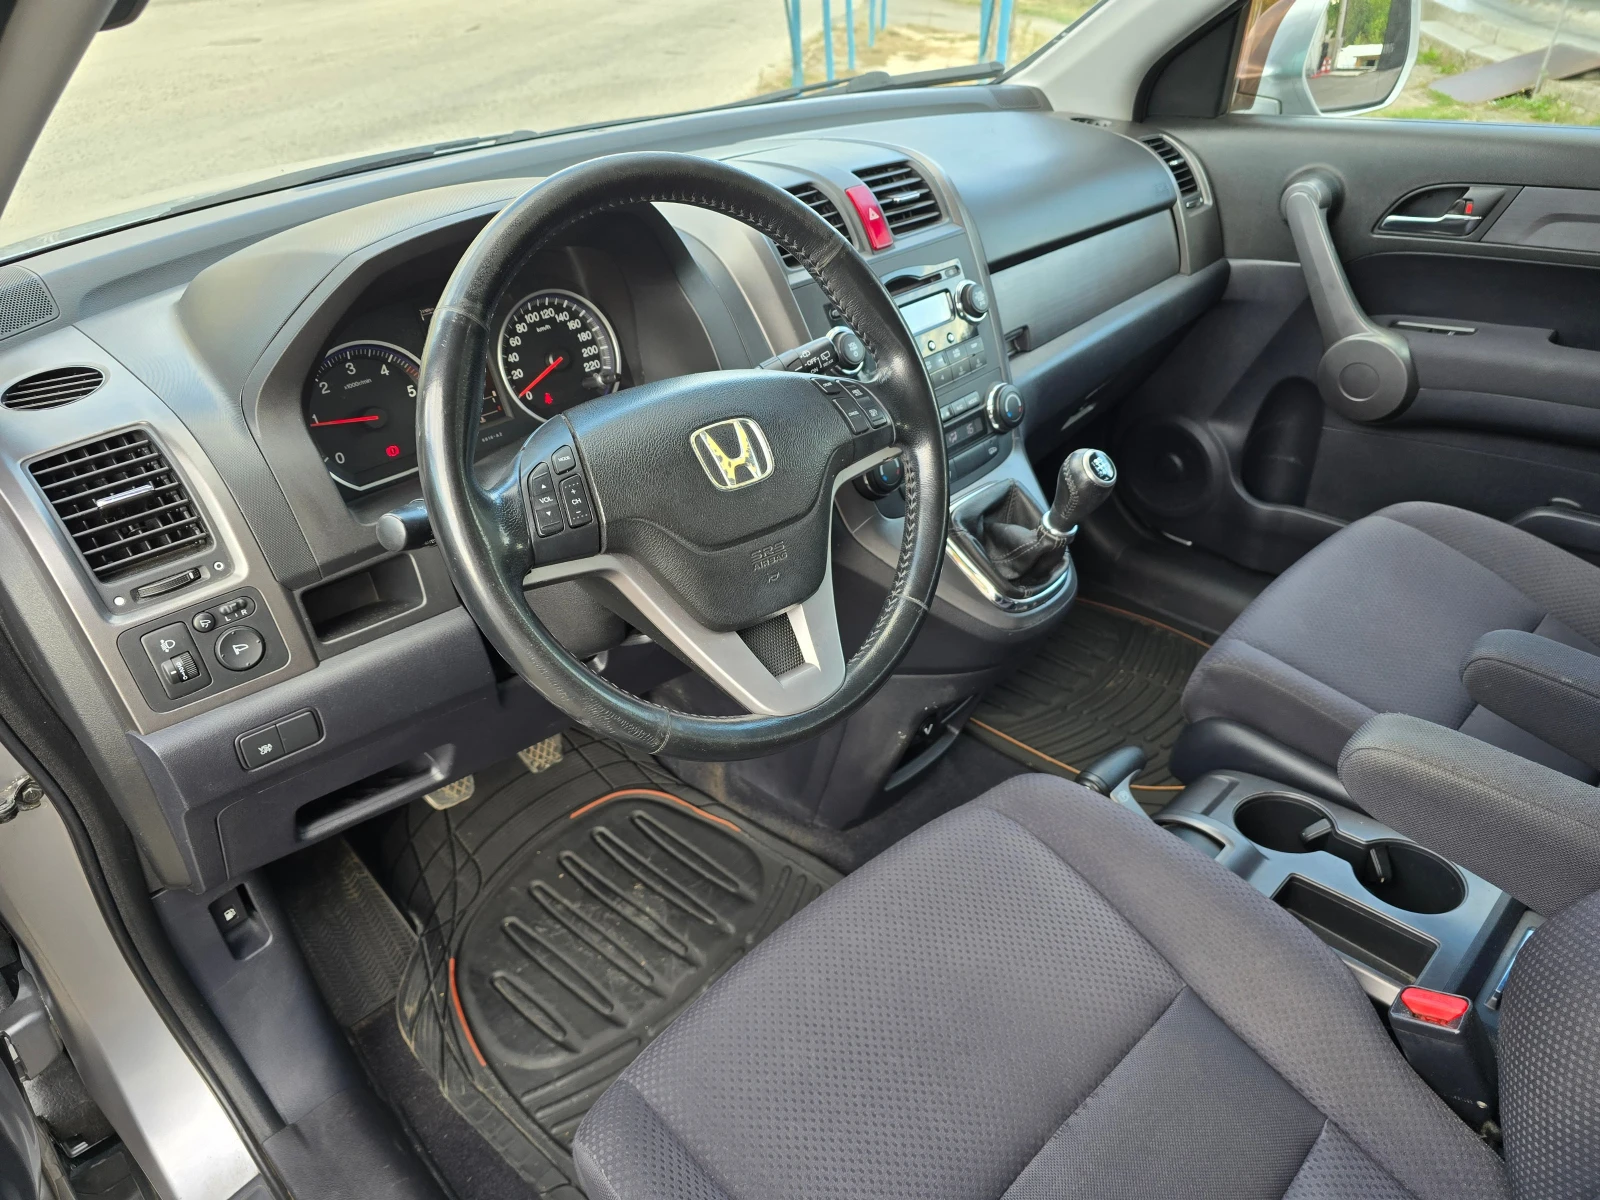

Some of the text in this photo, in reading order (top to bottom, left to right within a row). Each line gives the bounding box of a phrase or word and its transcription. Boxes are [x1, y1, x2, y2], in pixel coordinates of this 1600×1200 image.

[525, 312, 540, 324] 100
[540, 308, 555, 319] 120
[555, 311, 570, 323] 140
[516, 322, 528, 333] 80
[567, 319, 581, 330] 160
[509, 336, 521, 347] 60
[577, 330, 592, 342] 180
[507, 352, 520, 363] 40
[582, 345, 599, 358] 200
[345, 362, 356, 375] 3
[380, 363, 390, 376] 4
[583, 359, 601, 373] 220
[511, 368, 524, 380] 20
[319, 382, 330, 394] 2
[406, 384, 417, 398] 5
[525, 390, 533, 401] 0
[335, 452, 345, 464] 0
[539, 496, 554, 504] VOL
[571, 497, 582, 505] CH
[240, 608, 248, 616] R
